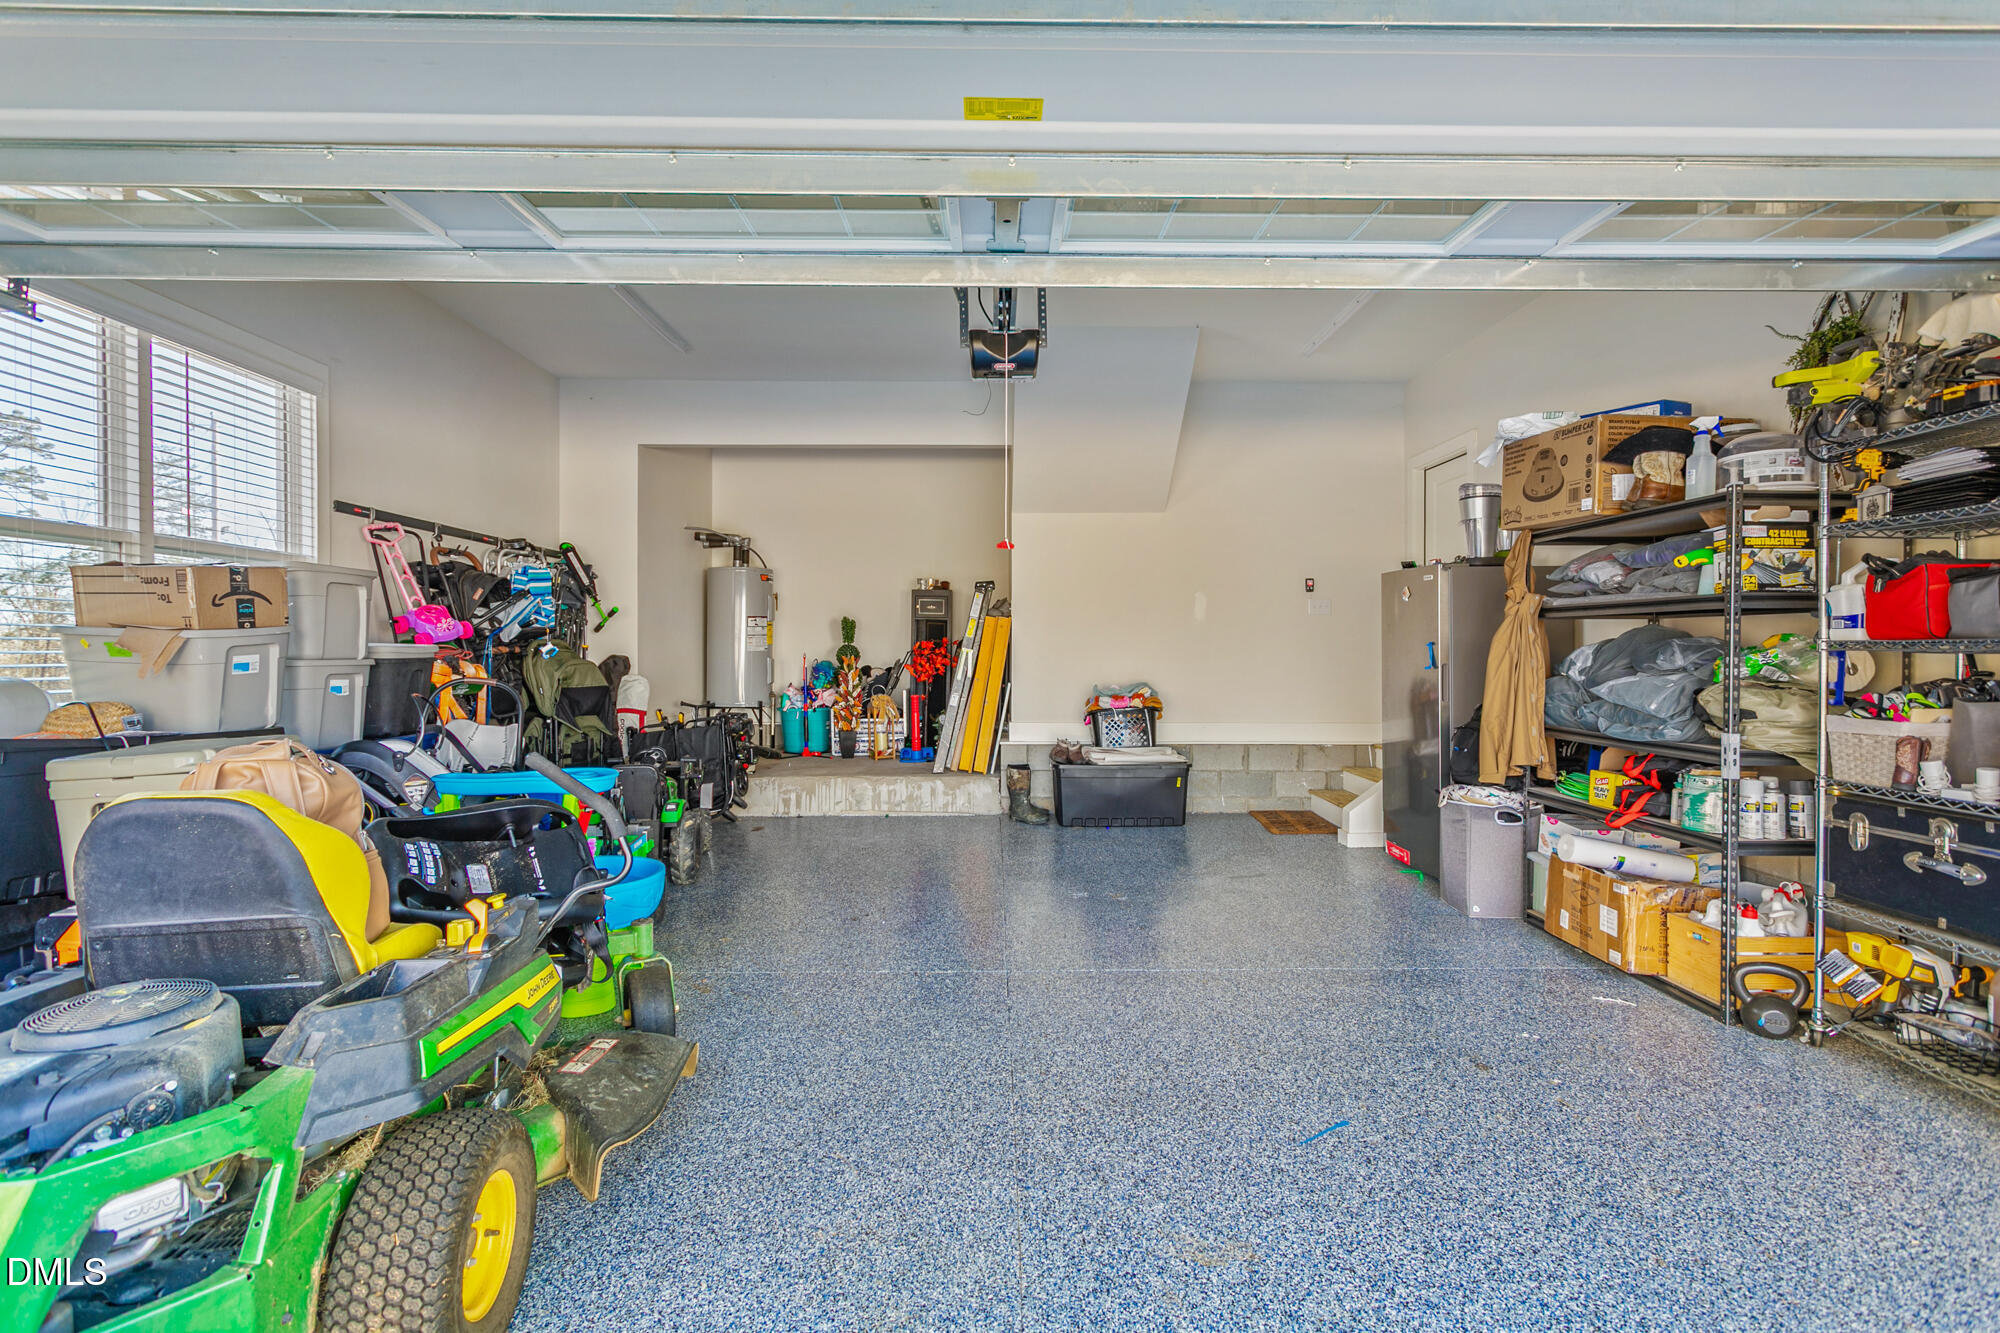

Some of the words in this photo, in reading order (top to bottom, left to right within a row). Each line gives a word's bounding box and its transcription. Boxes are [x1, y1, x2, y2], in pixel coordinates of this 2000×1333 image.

[1561, 424, 1582, 437] BUMPER
[1583, 420, 1595, 430] CAR
[1768, 529, 1780, 537] 42
[1780, 529, 1808, 538] GALLON
[1744, 537, 1795, 546] CONTRACTOR
[140, 575, 170, 586] From:
[1744, 576, 1757, 584] 24
[157, 593, 173, 604] To:
[527, 984, 540, 1000] JOHN
[540, 970, 554, 988] DEERE
